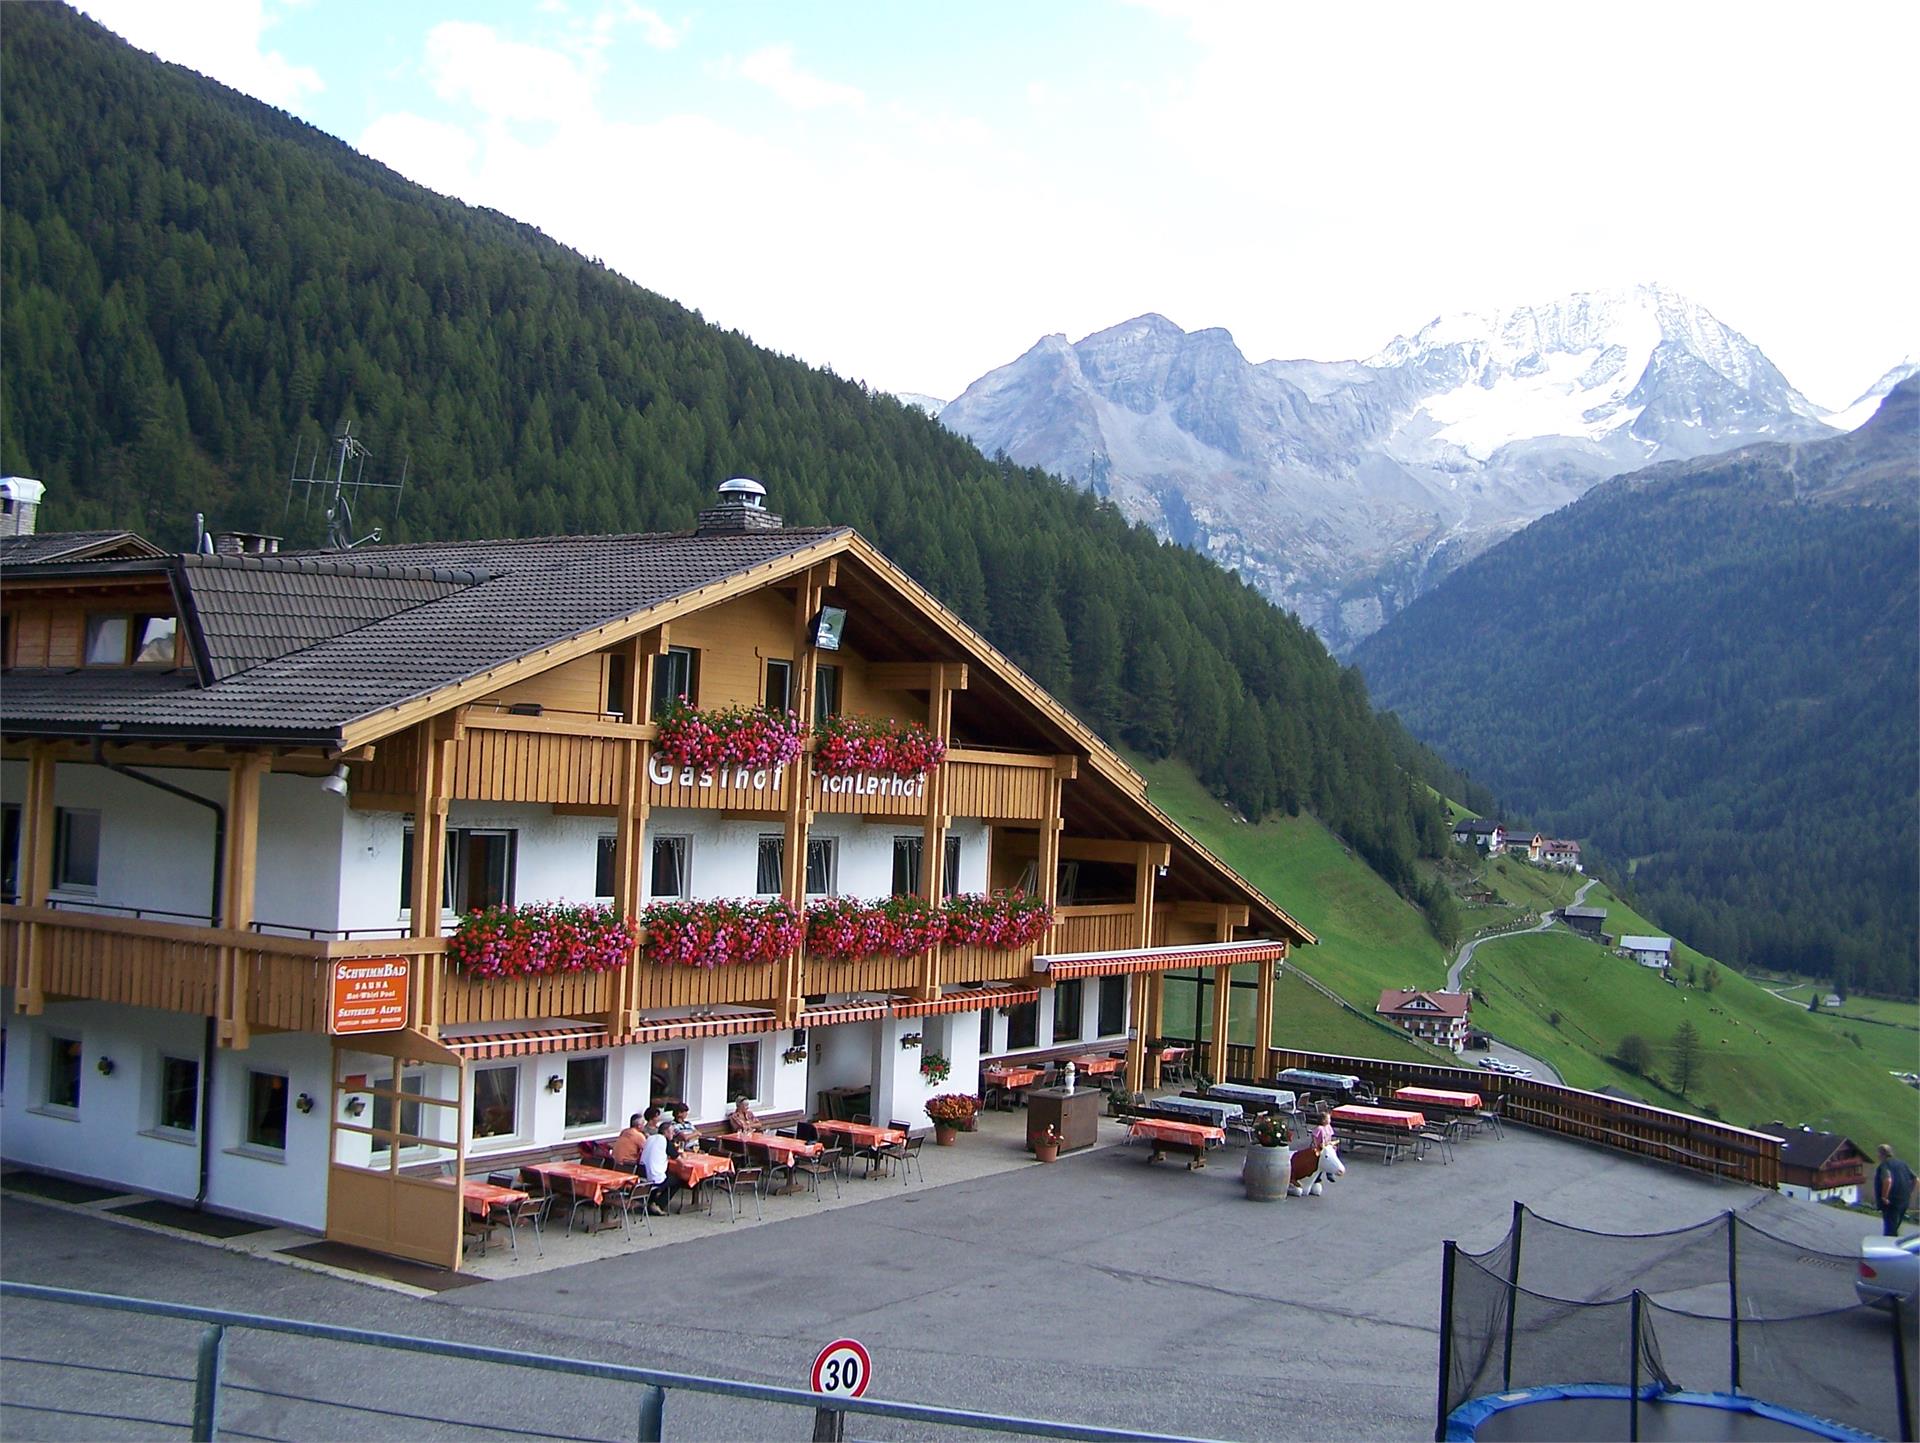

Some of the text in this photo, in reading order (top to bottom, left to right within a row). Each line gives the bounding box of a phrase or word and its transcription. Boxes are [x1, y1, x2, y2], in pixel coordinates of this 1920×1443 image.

[648, 751, 785, 791] Gasthof
[355, 981, 388, 990] SAUNA
[825, 1358, 858, 1391] 30
